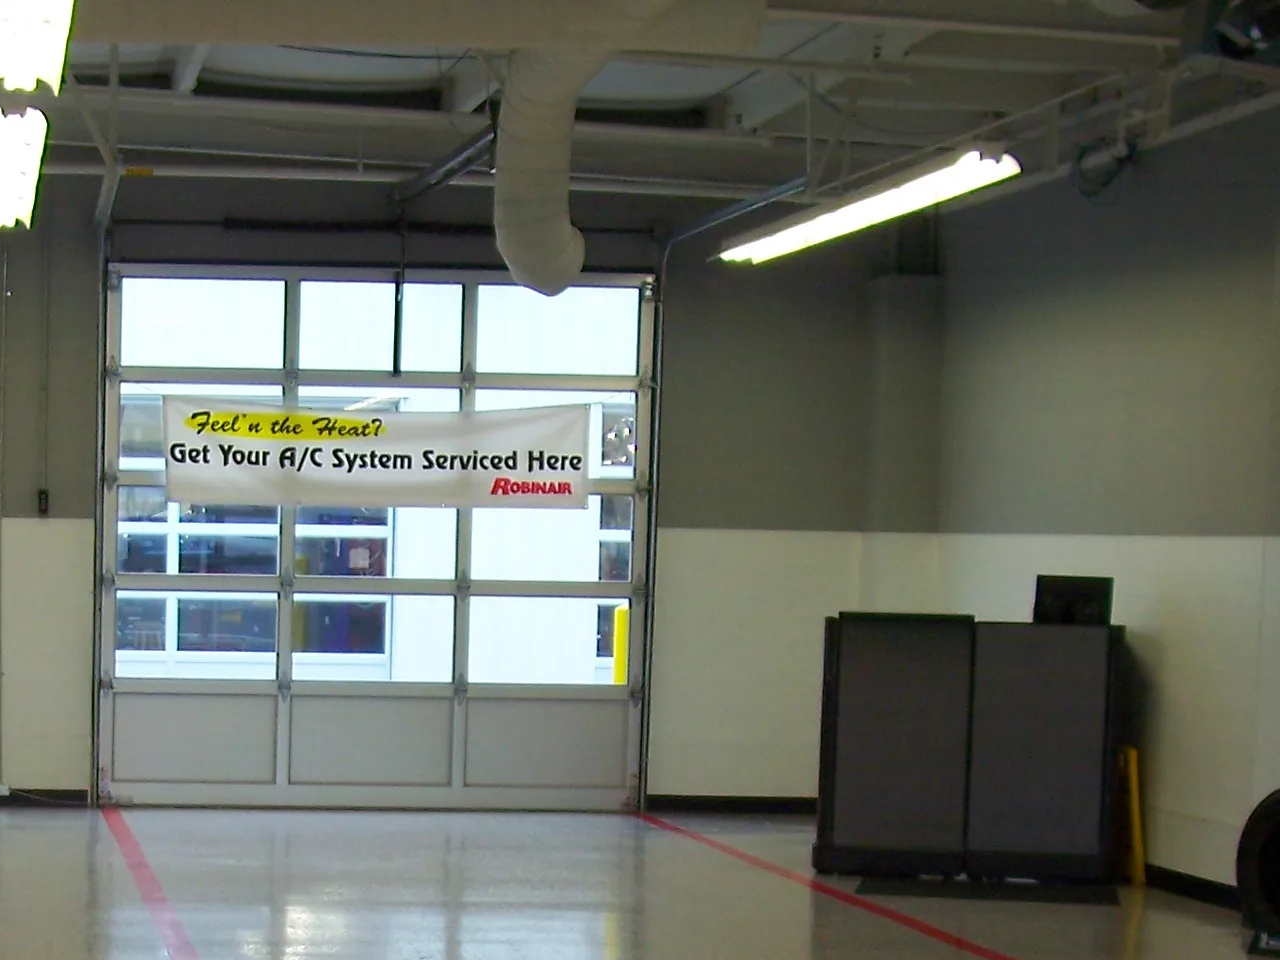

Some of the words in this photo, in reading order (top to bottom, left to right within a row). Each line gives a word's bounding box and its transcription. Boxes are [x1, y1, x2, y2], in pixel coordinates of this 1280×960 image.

[270, 416, 304, 435] the
[312, 416, 384, 438] Heat?
[169, 442, 211, 465] Get
[218, 444, 271, 467] Your
[278, 447, 323, 472] A/C
[332, 448, 413, 474] System
[422, 450, 517, 471] Serviced
[528, 450, 583, 472] Here
[490, 477, 573, 496] ROBINAIR
